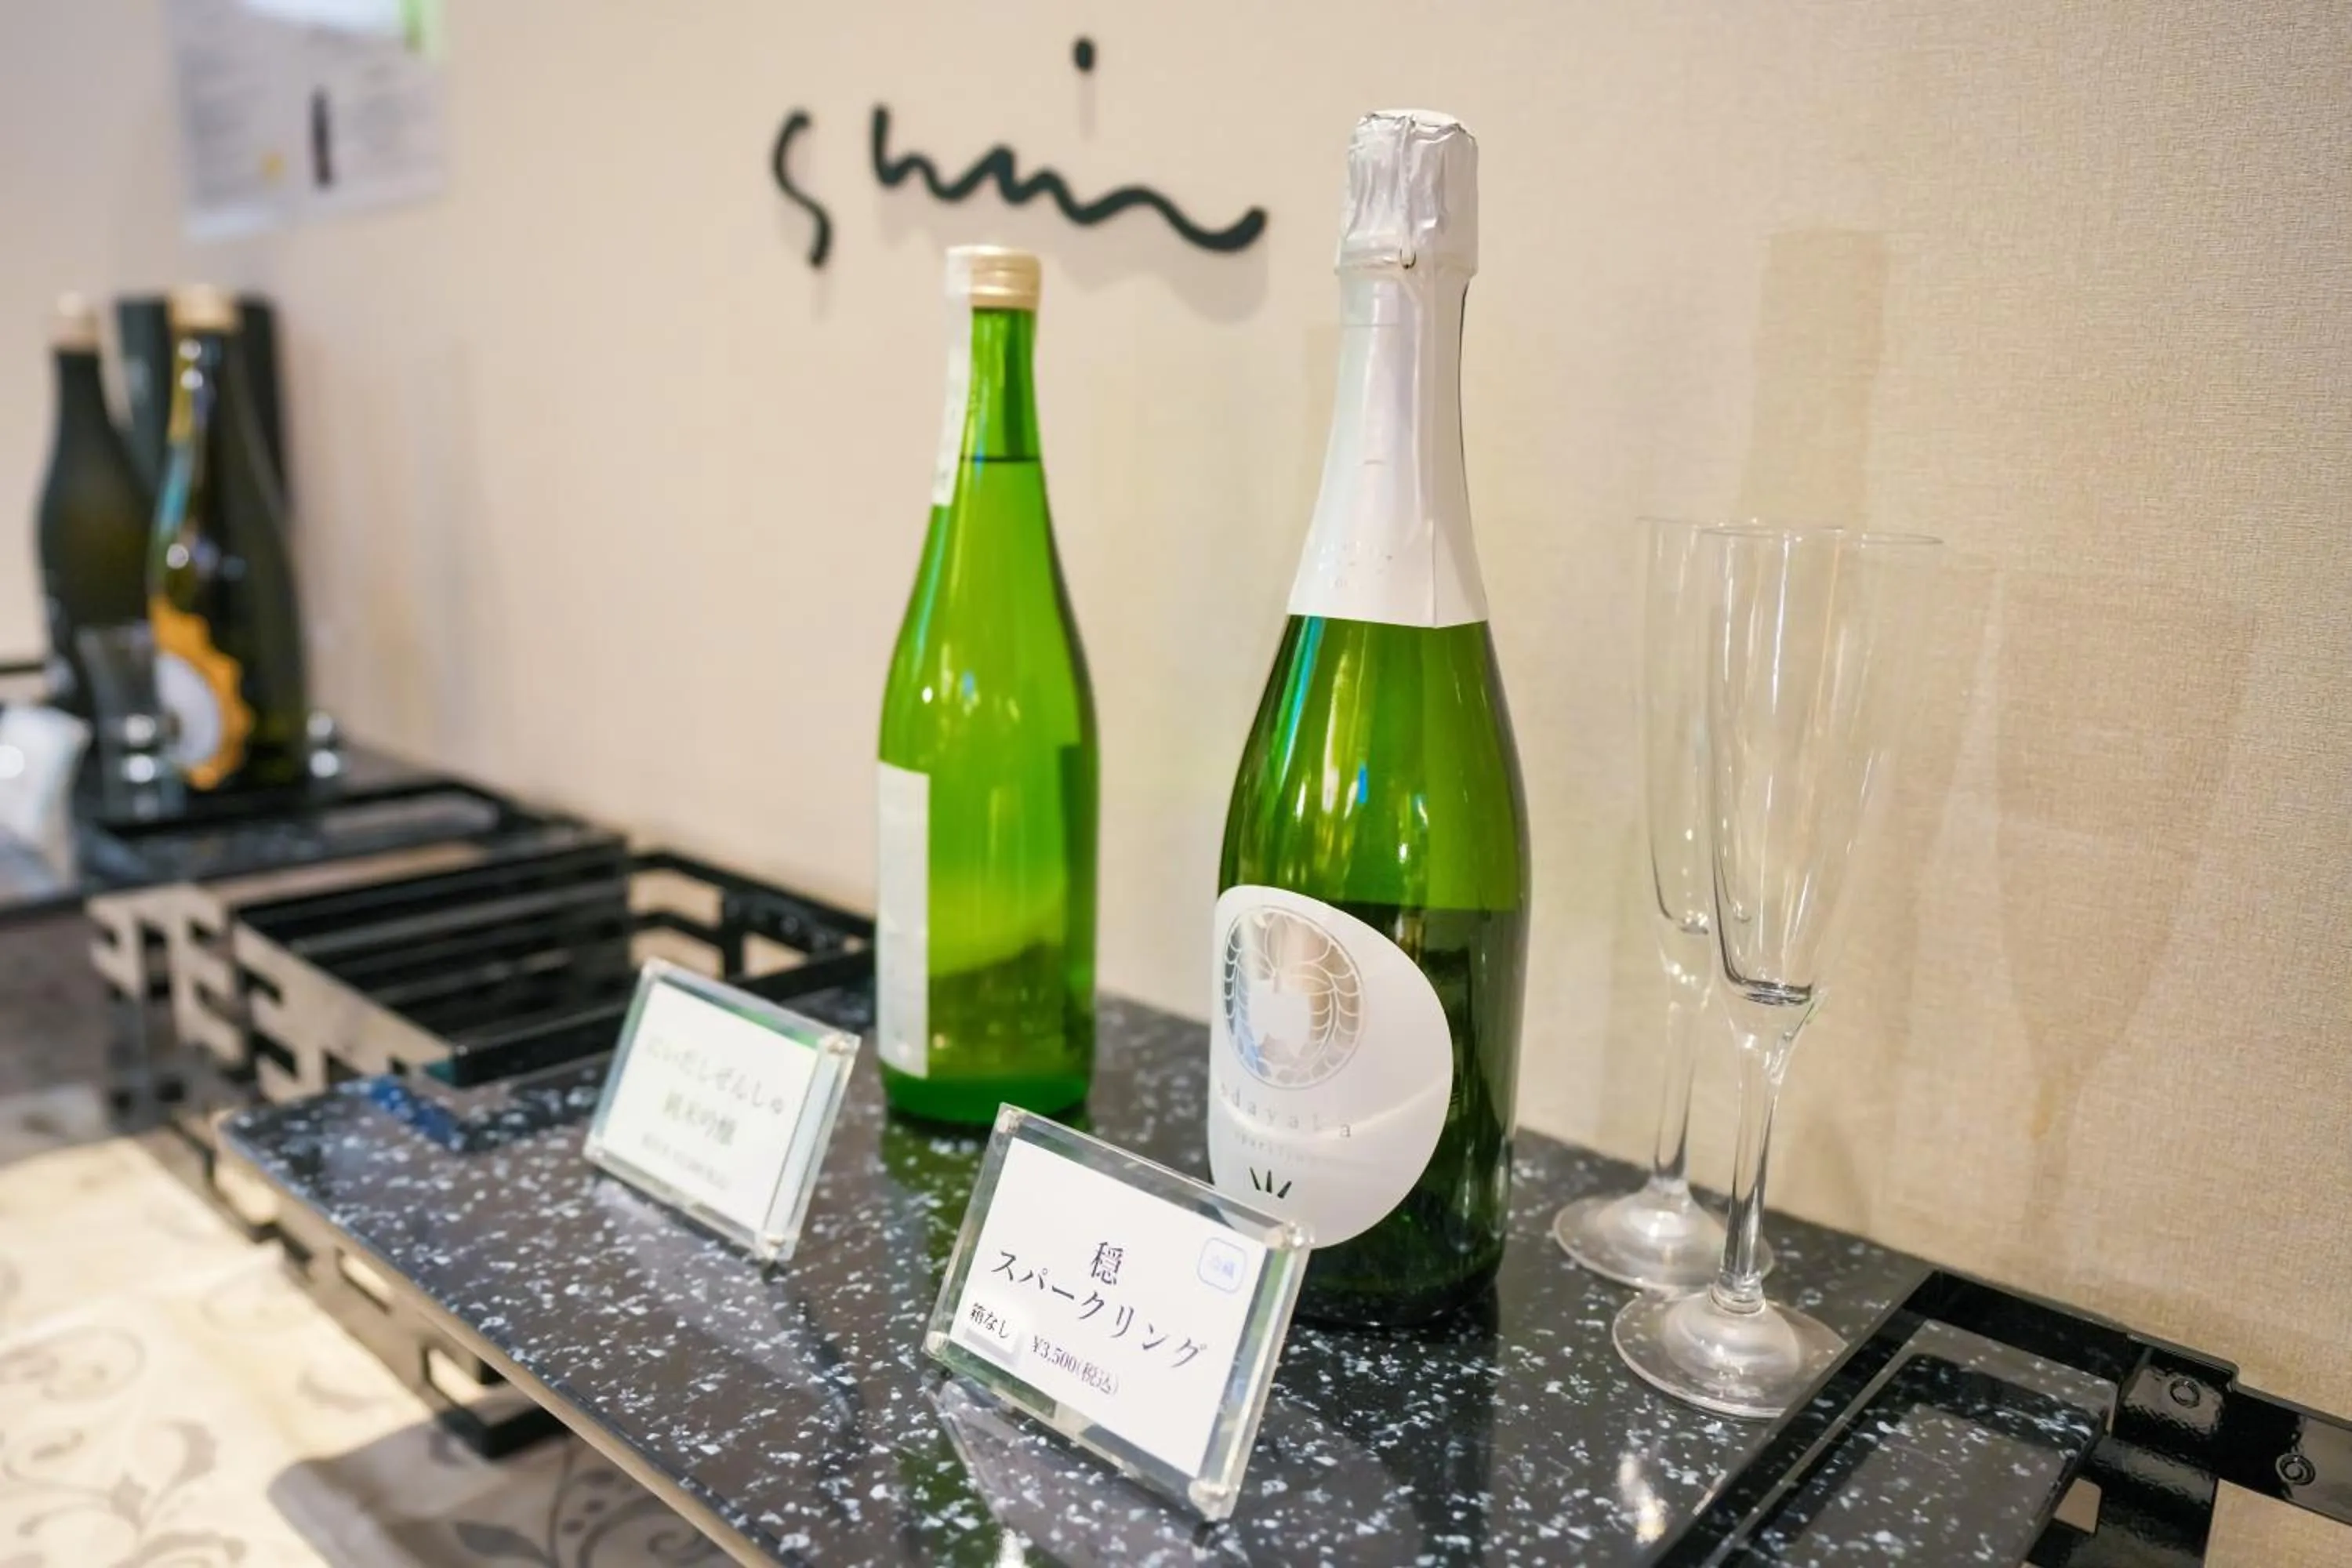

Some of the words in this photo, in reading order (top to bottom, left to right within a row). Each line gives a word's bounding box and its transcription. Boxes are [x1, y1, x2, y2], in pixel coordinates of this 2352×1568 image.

[1091, 1240, 1125, 1286] 穏
[969, 1301, 1009, 1339] 箱なし
[991, 1250, 1207, 1369] スパークリング
